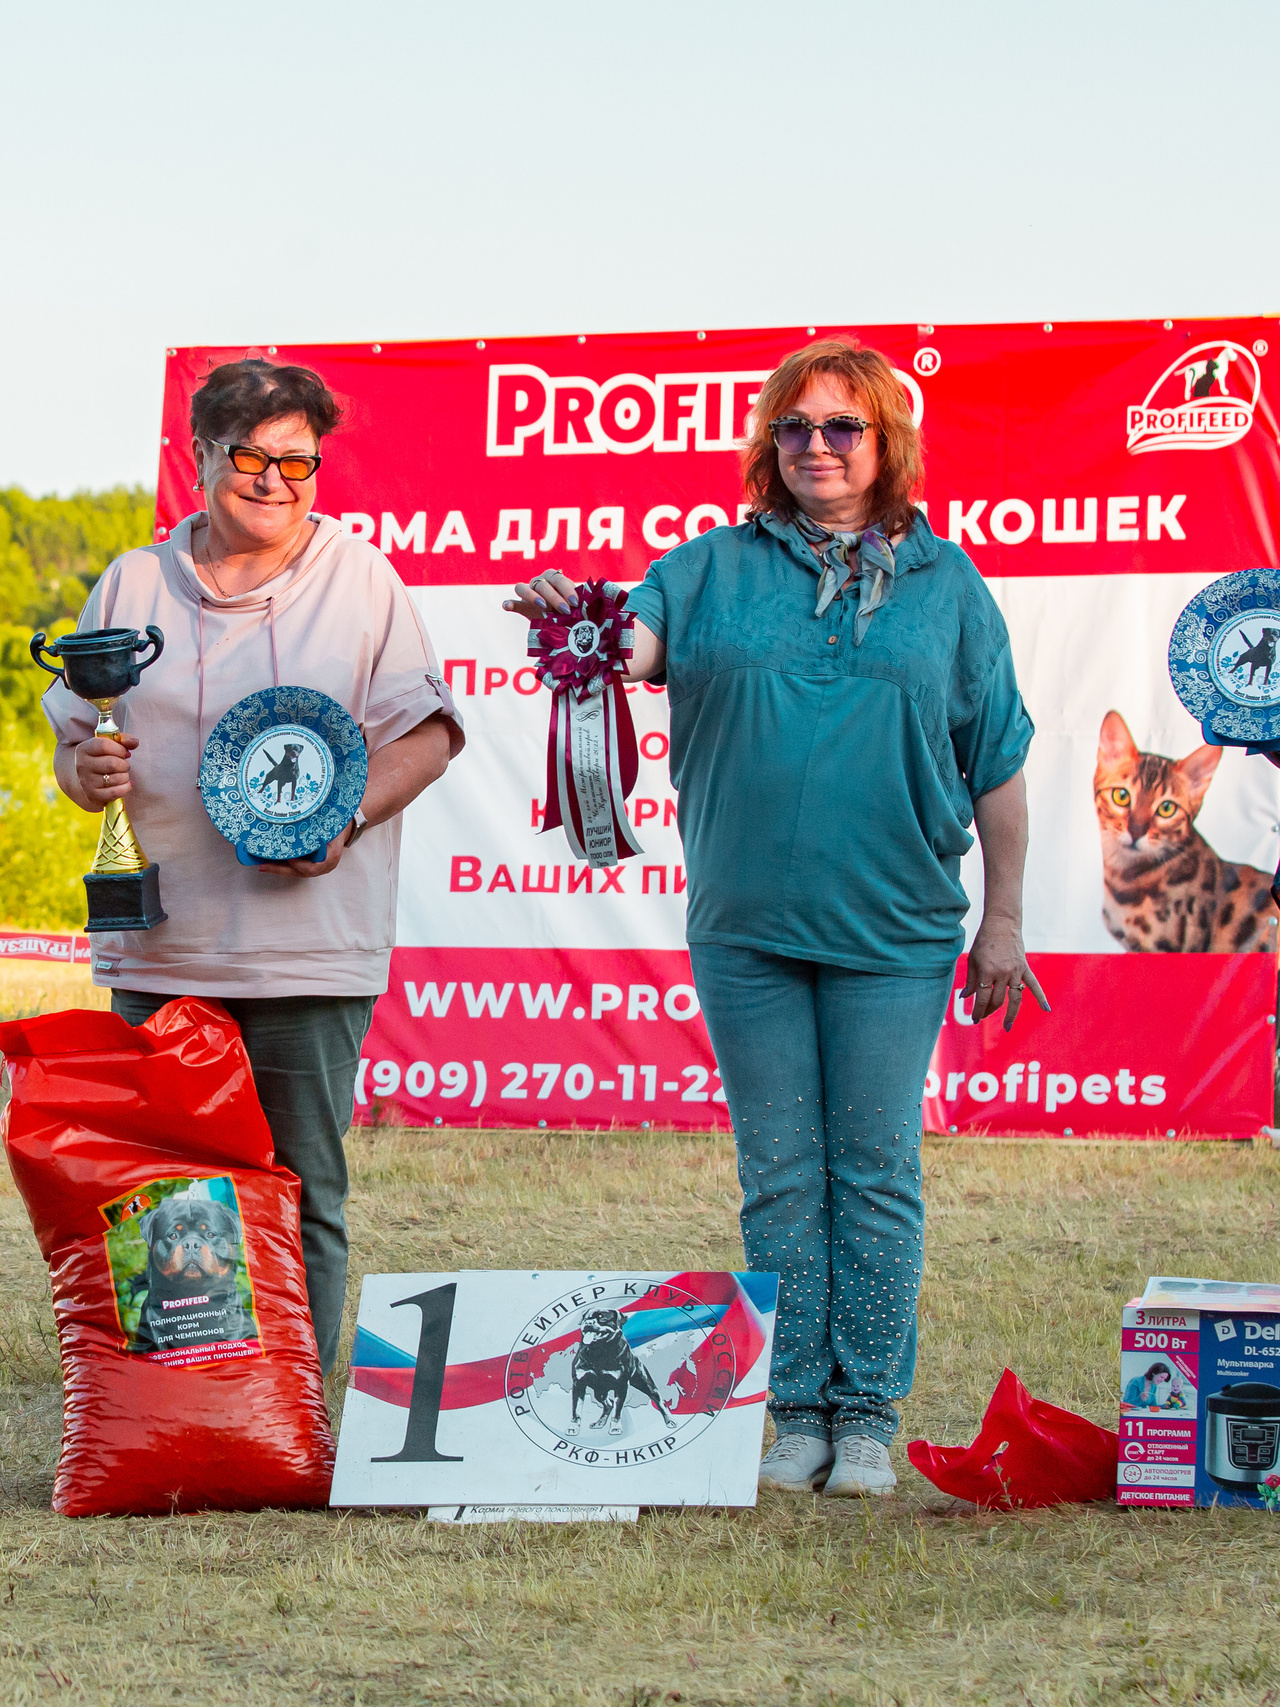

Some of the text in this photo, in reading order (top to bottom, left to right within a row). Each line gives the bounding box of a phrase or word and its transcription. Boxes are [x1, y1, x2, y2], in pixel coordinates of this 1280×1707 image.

[1127, 406, 1253, 435] PROFIFEED
[340, 511, 476, 554] РМА
[489, 507, 623, 560] ДЛЯ
[948, 494, 1187, 546] КОШЕК
[586, 822, 612, 837] ЛУЧШИЙ
[589, 837, 612, 849] ЮНИОР
[450, 855, 625, 894] ВАШИХ
[354, 1060, 488, 1107] (909)
[163, 1295, 209, 1310] PROFIFEED
[150, 1308, 227, 1328] ПОЛНОРАЦИОННЫЙ
[177, 1321, 200, 1331] КОРМ
[1135, 1310, 1187, 1327] 3 ЛИТРА
[157, 1327, 225, 1344] ДЛЯ ЧЕМПИОНОВ
[1134, 1332, 1187, 1349] 500 Вт
[217, 1341, 248, 1351] ПОДХОД
[508, 1282, 734, 1418] РОТВЕЙЛЕР КЛУБ РОССИИ
[186, 1354, 212, 1364] ВАШИХ
[1217, 1358, 1274, 1369] Мультиварка
[370, 1282, 464, 1463] 1
[1125, 1421, 1191, 1437] 11 ПРОГРАММ
[553, 1435, 677, 1466] РКФ-НКПР
[1121, 1491, 1190, 1501] ДЕТСКОЕ ПИТАНИЕ
[470, 1505, 504, 1514] Корма
